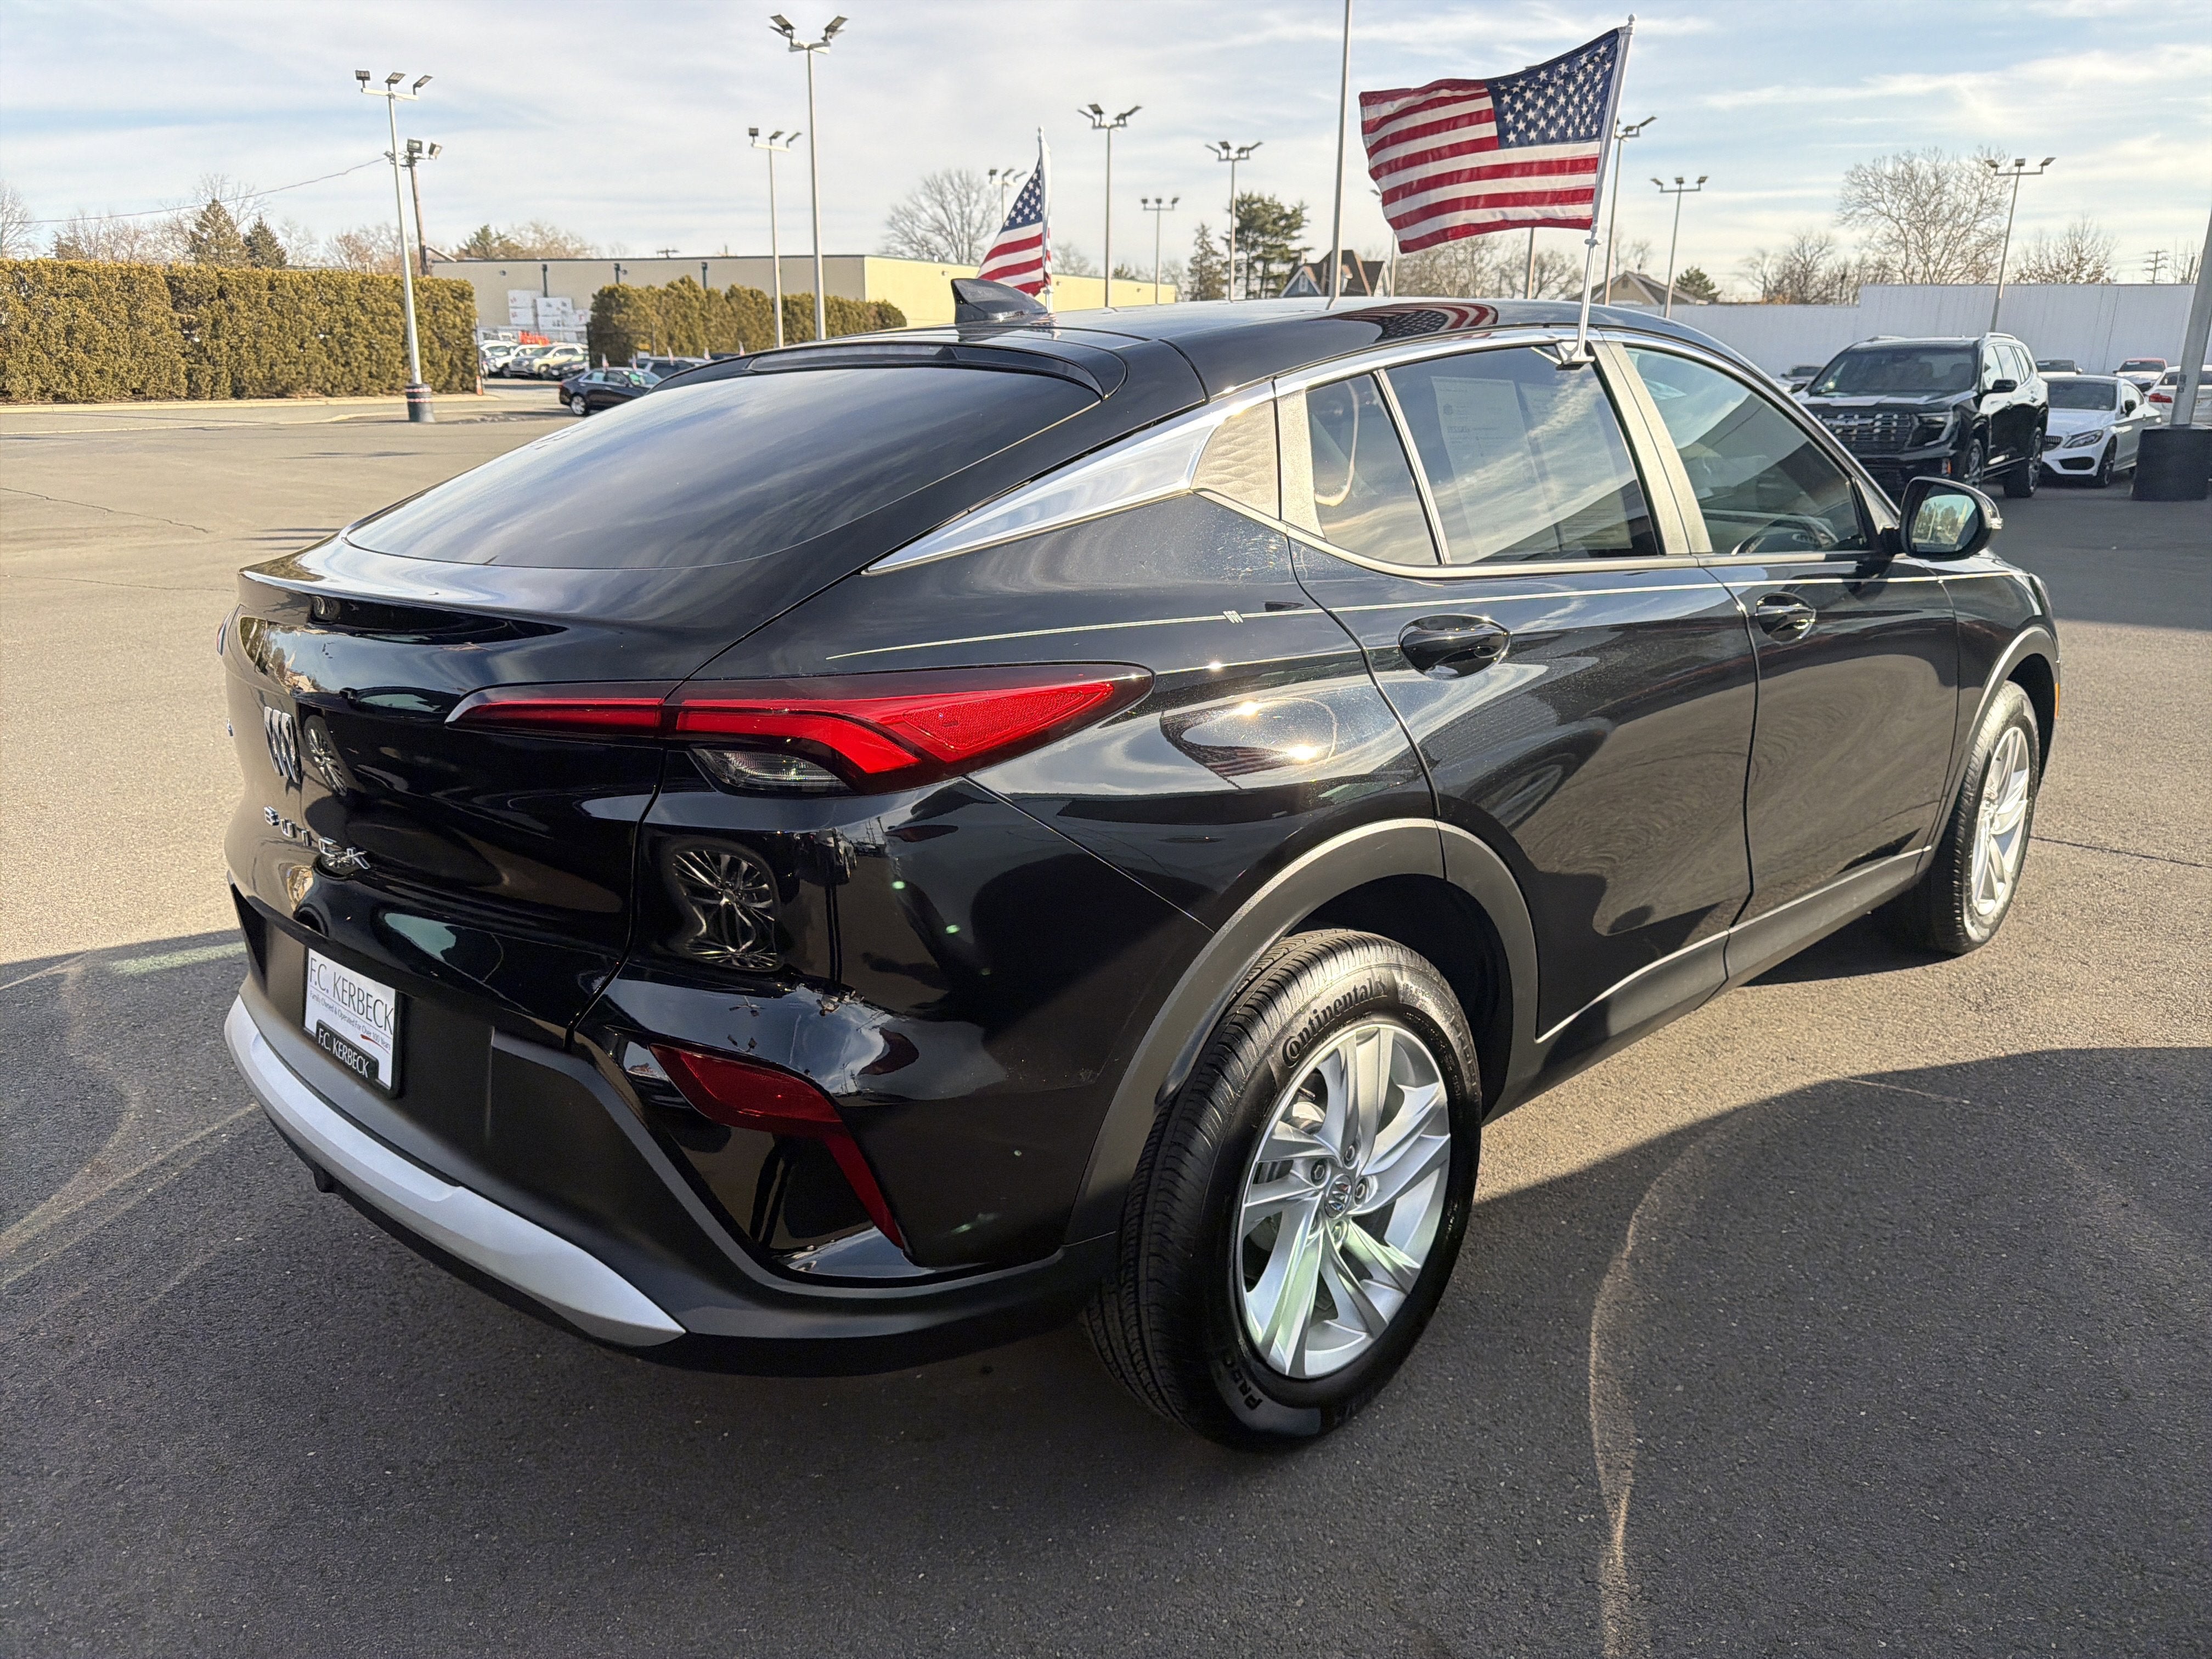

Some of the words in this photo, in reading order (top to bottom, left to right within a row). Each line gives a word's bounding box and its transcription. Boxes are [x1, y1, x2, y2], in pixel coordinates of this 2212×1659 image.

[310, 957, 329, 994] F.C.
[333, 972, 394, 1035] KERBECK
[1282, 977, 1380, 1068] Continental
[332, 1038, 369, 1078] KERBECK
[372, 1032, 380, 1042] 100
